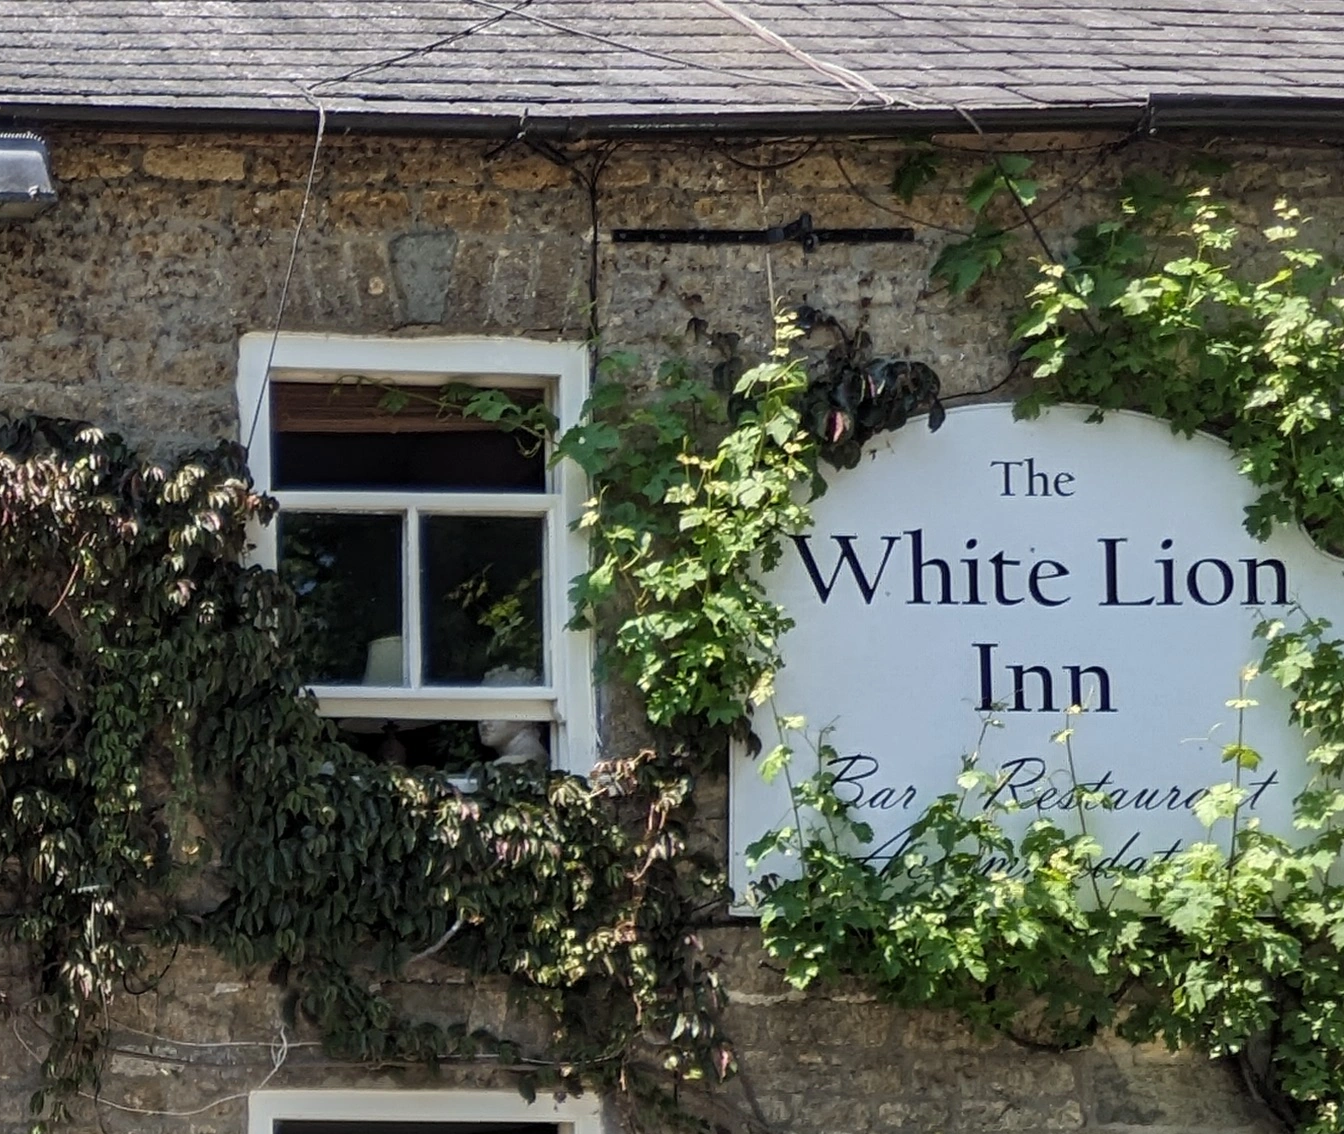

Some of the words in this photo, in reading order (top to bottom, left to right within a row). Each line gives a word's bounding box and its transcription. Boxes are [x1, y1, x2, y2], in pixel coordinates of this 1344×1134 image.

[989, 458, 1076, 498] The
[788, 528, 1072, 608] White
[1097, 538, 1294, 608] Lion
[972, 642, 1119, 714] Inn
[827, 754, 917, 811] Bar
[983, 756, 1279, 812] Restaurat
